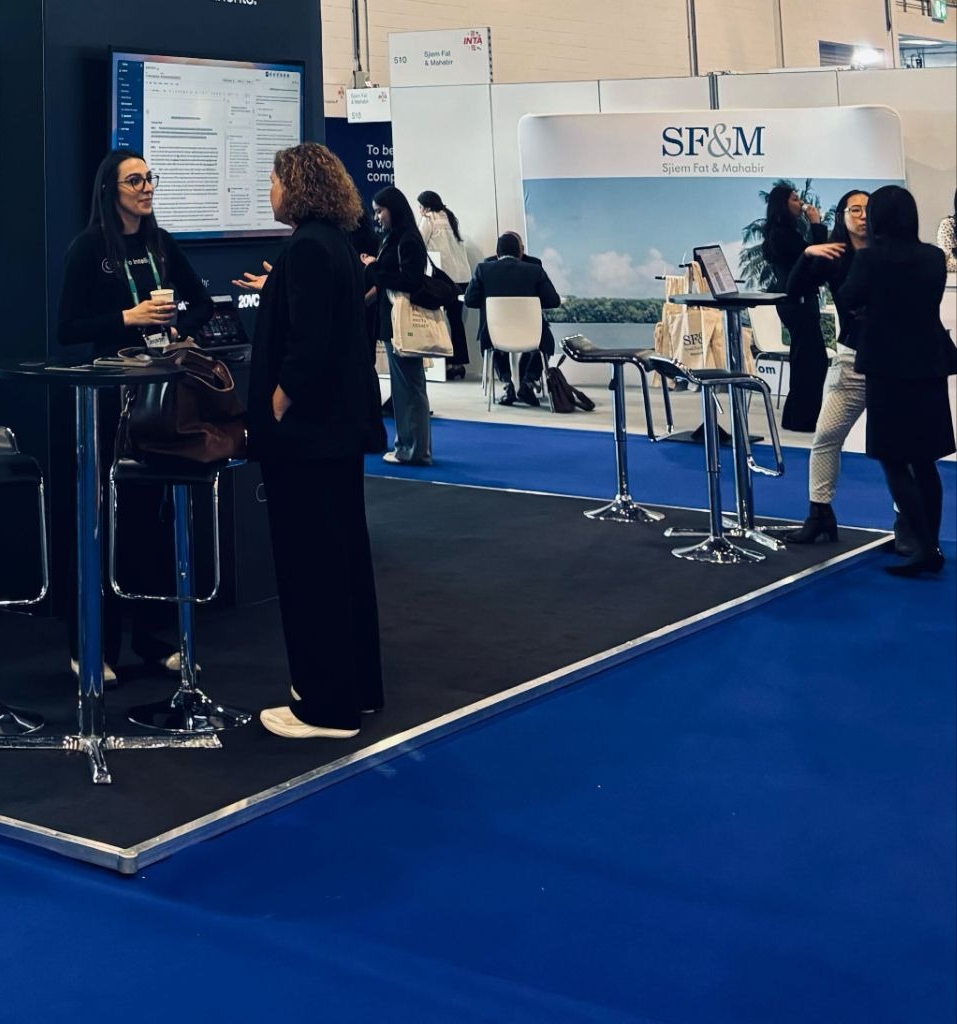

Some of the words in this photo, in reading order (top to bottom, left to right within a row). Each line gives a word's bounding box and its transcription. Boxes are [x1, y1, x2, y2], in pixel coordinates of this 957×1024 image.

[662, 123, 766, 160] SF&M
[366, 144, 380, 155] To
[366, 159, 373, 169] a
[662, 163, 691, 175] Sjiem
[693, 163, 709, 173] Fat
[712, 163, 720, 173] &
[722, 163, 765, 173] Mahabir
